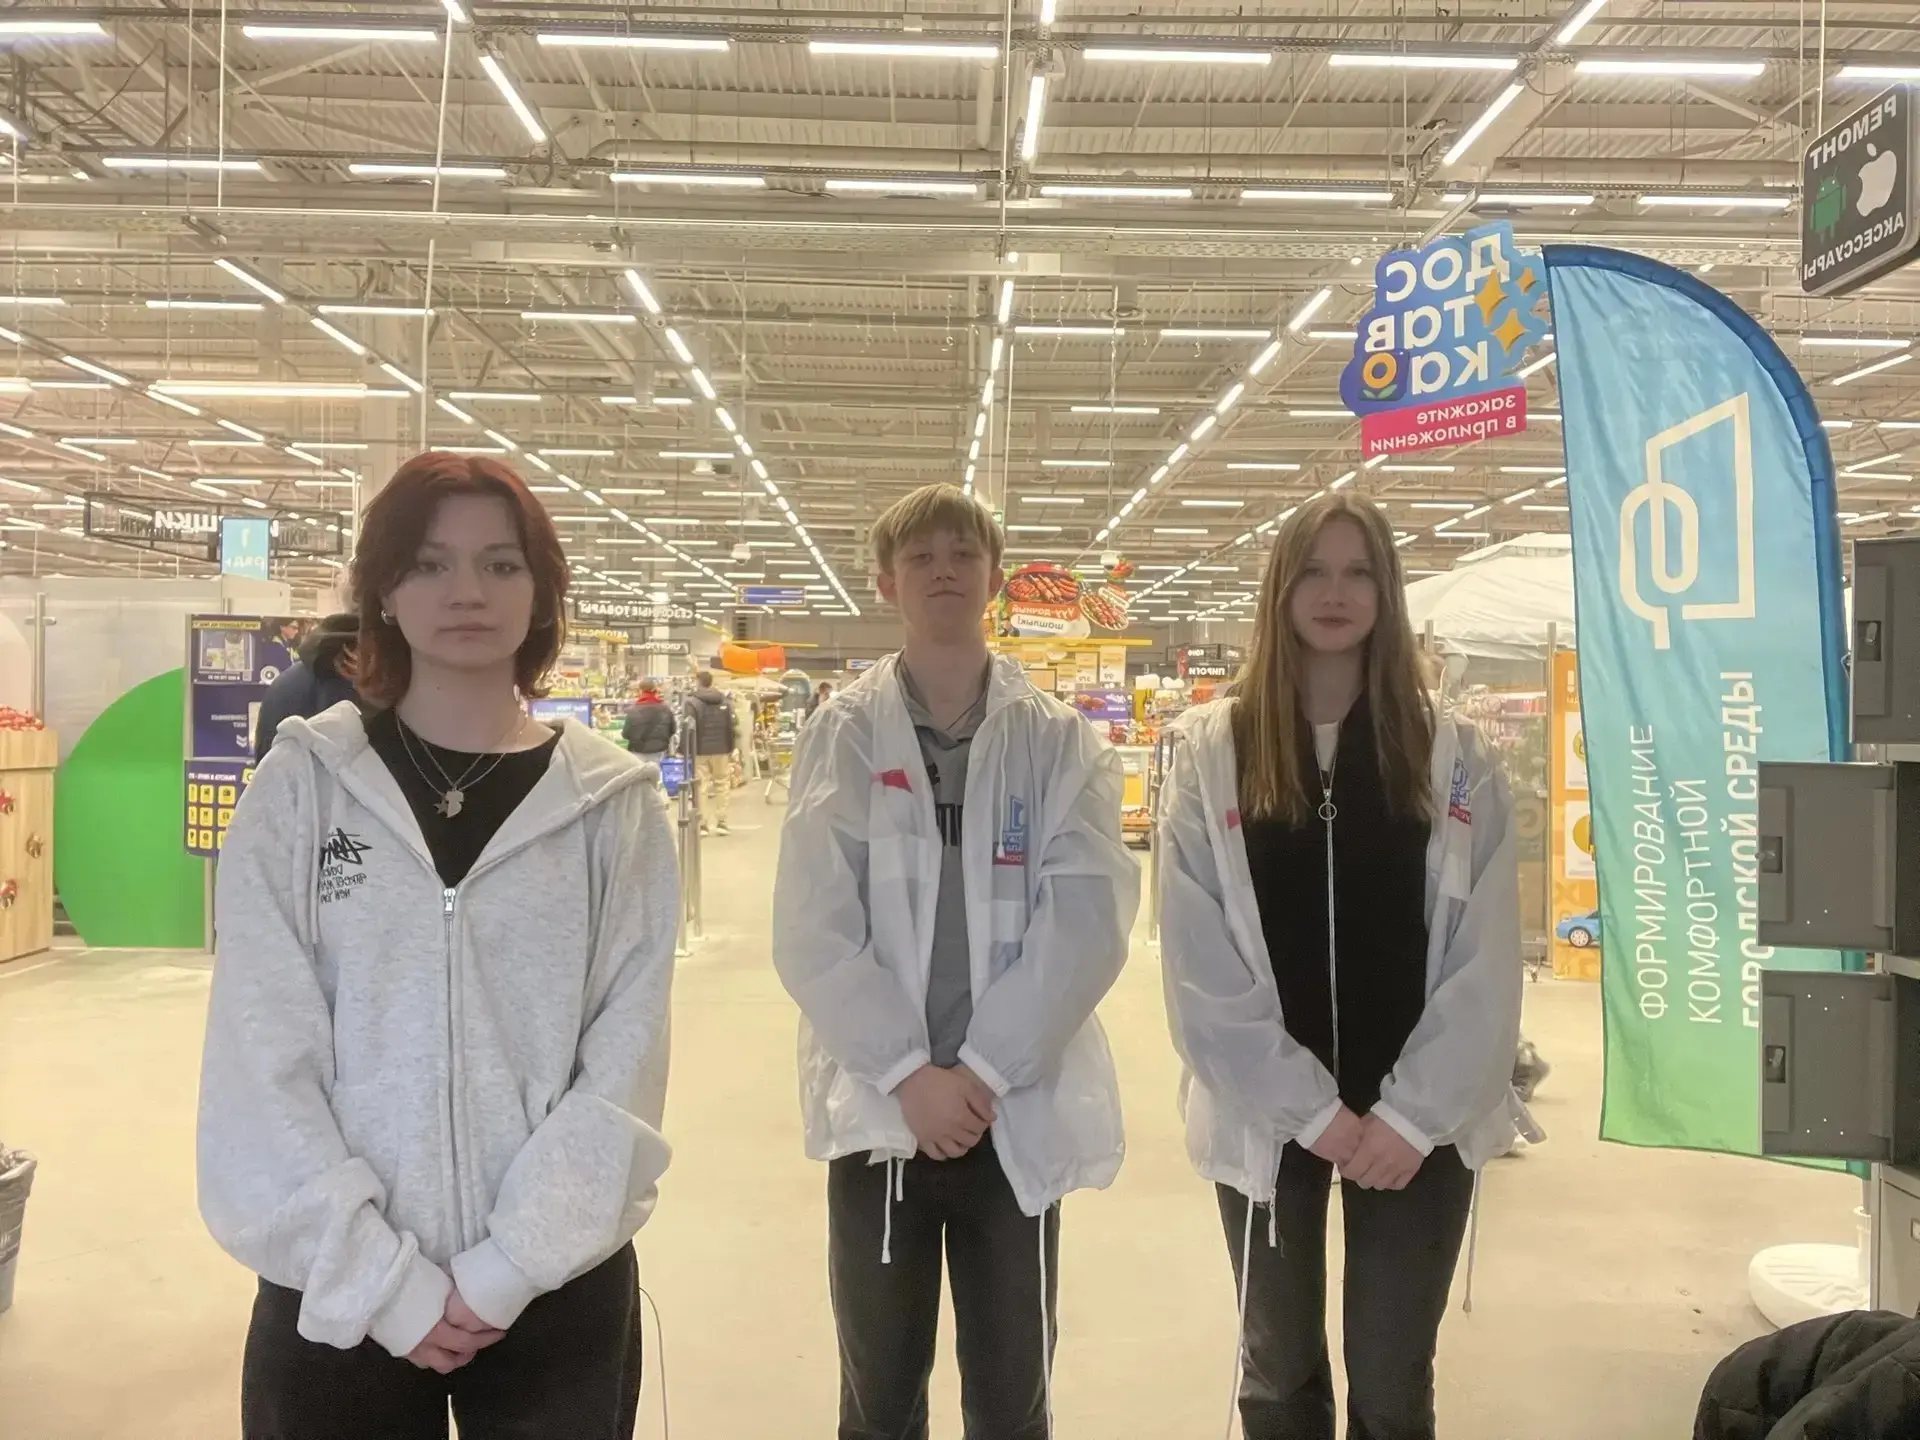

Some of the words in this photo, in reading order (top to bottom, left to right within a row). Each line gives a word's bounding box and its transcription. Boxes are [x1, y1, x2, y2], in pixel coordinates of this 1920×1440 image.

[1719, 672, 1764, 800] СРЕДЫ
[1630, 724, 1668, 1019] ФОРМИРОВАНИЕ
[1668, 779, 1722, 1023] КОМФОРТНОЙ
